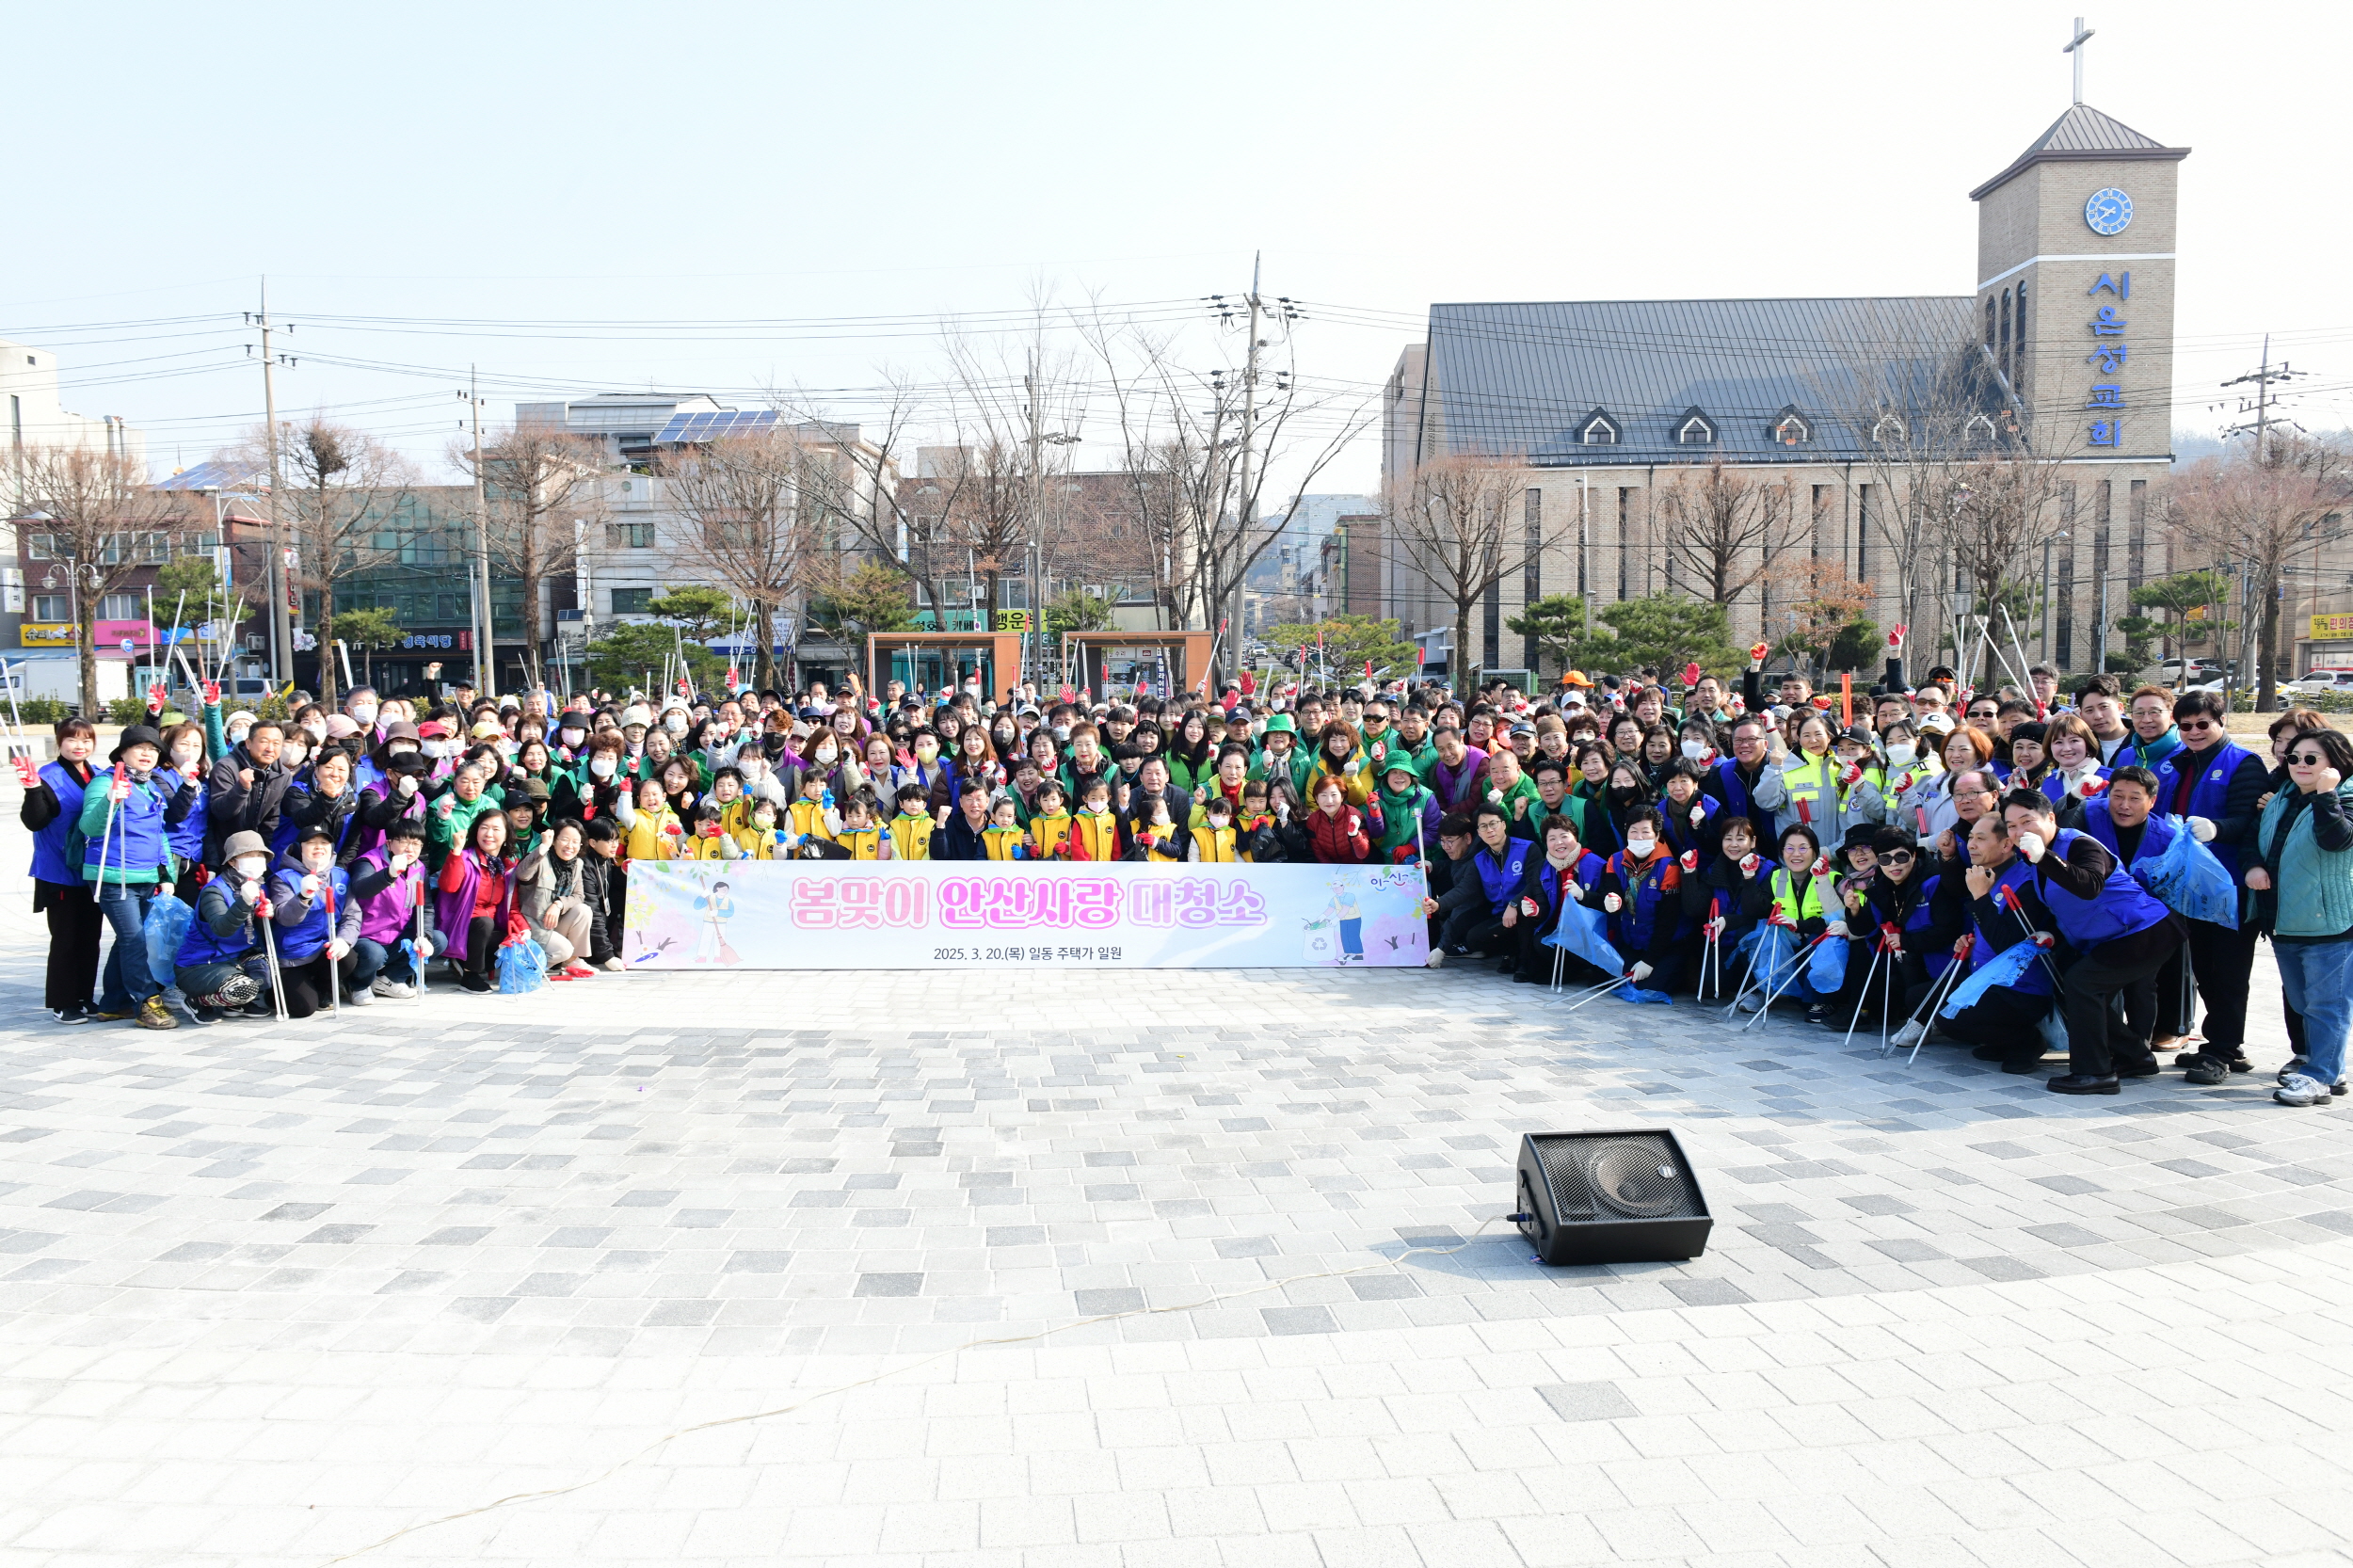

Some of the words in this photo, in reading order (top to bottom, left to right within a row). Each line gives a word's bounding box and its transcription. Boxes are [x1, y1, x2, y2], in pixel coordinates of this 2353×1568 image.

[2086, 271, 2130, 448] 시온성교회
[1928, 714, 1940, 723] C
[792, 878, 927, 927] 봄맞이
[939, 878, 1121, 927] 안산사랑
[1130, 878, 1265, 927] 대청소
[934, 948, 968, 960] 2025.
[971, 948, 982, 960] 3.
[985, 947, 1025, 961] 20.(목)
[1030, 947, 1053, 961] 일동
[1057, 947, 1094, 961] 주택가
[1097, 947, 1122, 961] 일원
